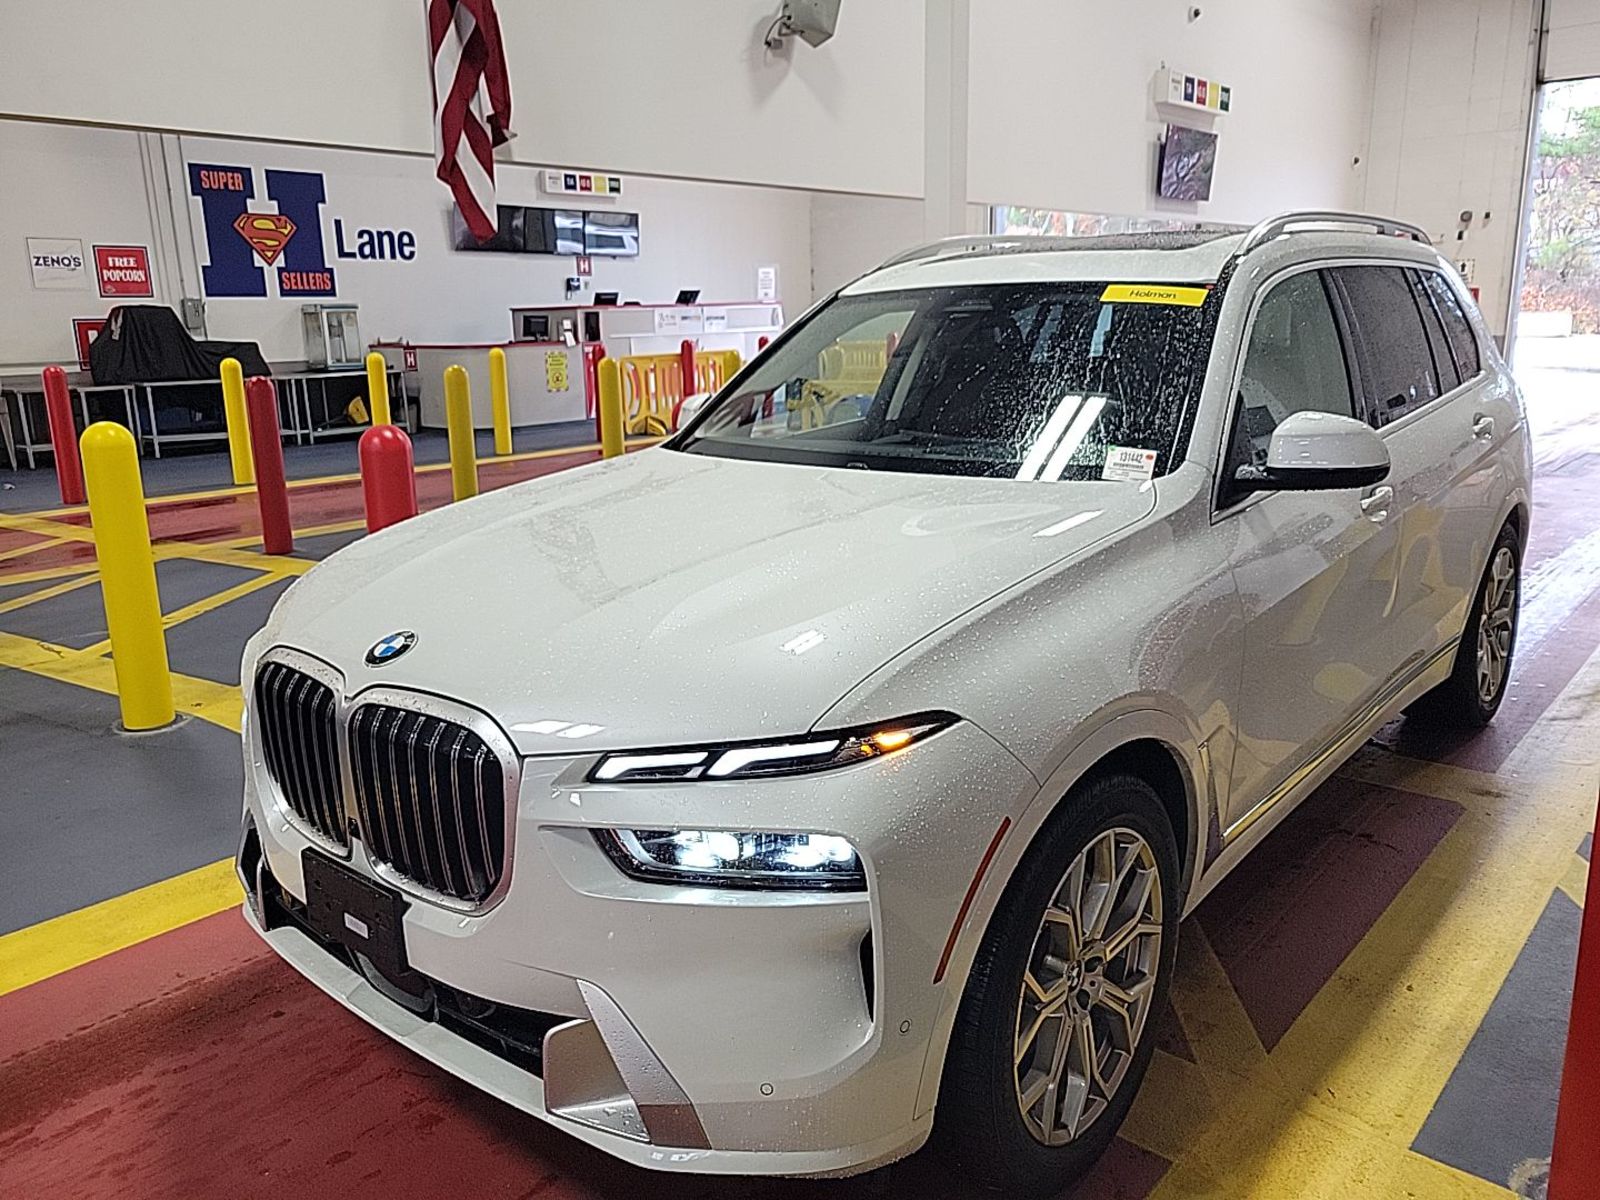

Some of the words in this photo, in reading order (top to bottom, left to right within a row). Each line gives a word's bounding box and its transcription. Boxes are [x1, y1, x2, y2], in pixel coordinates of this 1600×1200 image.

[200, 170, 244, 191] SUPER
[335, 219, 416, 261] Lane
[33, 255, 82, 268] ZENO'S
[108, 256, 138, 268] FREE
[103, 269, 146, 282] POPCORN
[281, 271, 332, 290] SELLERS
[1129, 290, 1177, 299] Holman
